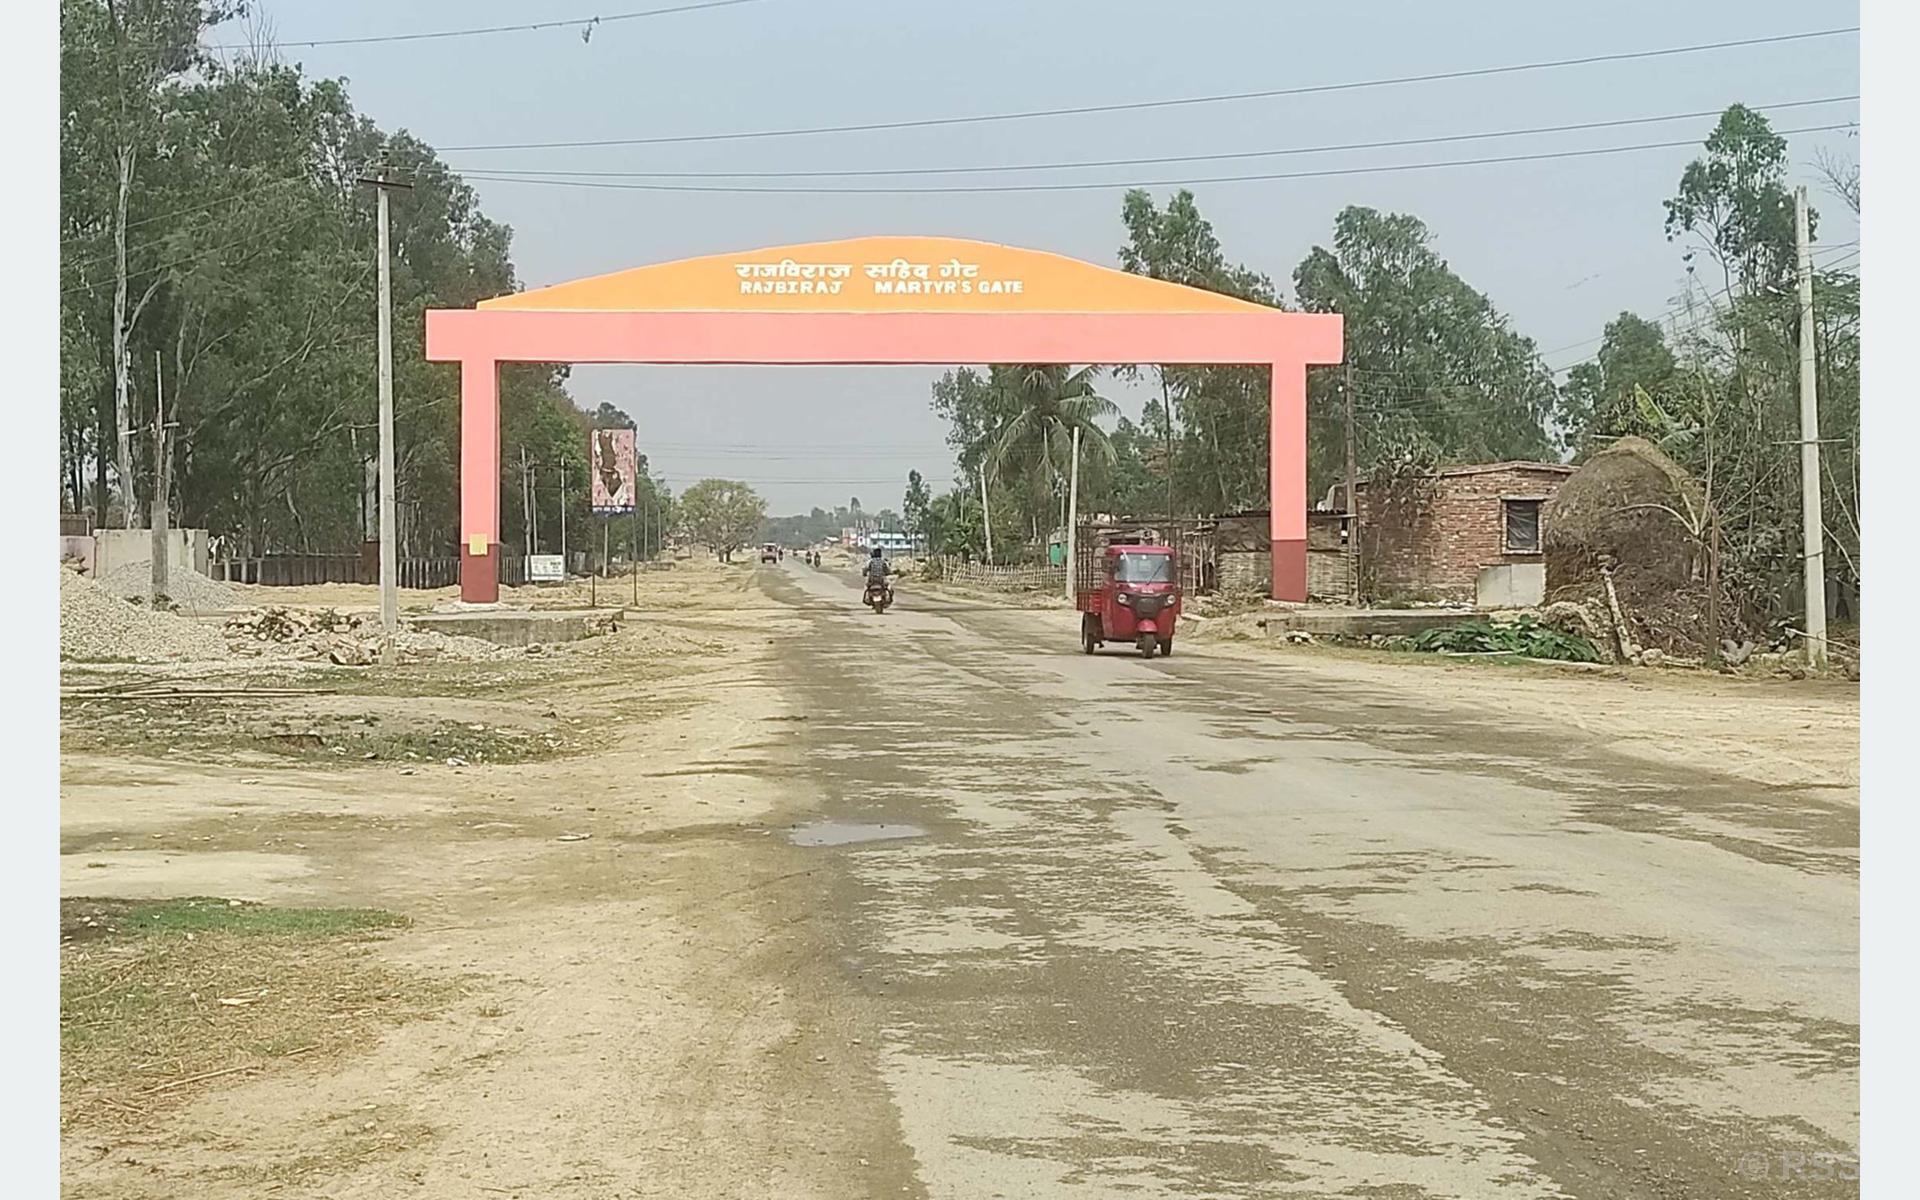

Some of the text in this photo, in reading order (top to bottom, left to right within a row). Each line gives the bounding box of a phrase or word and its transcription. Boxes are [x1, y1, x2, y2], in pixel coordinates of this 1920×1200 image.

[734, 259, 852, 278] राजविराज
[938, 259, 979, 277] गेट
[740, 280, 1023, 294] RAJBIRAJ MARTYR'S GATE
